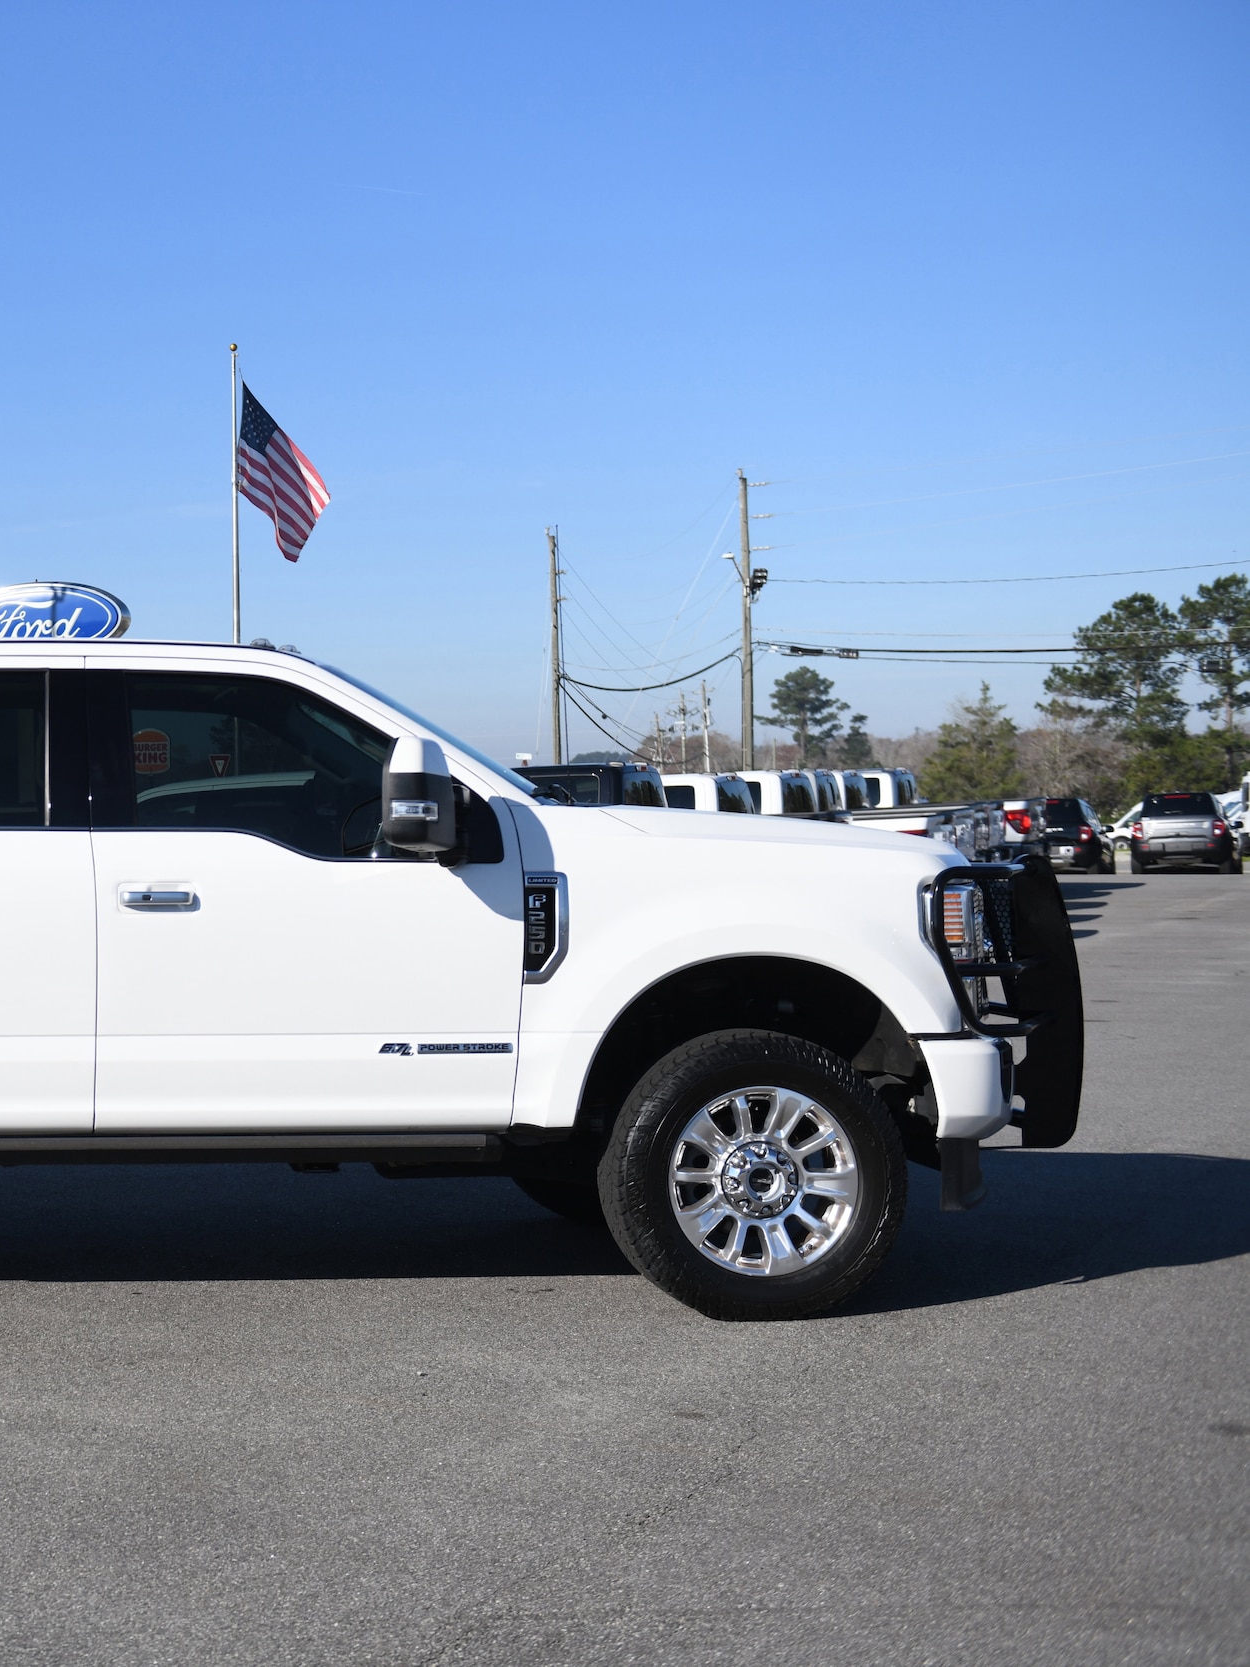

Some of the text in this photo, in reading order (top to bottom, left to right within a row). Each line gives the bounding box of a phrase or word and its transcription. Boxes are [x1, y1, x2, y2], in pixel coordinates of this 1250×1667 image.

[133, 752, 168, 764] KING
[419, 1043, 460, 1052] POWER
[462, 1042, 510, 1051] STROKE
